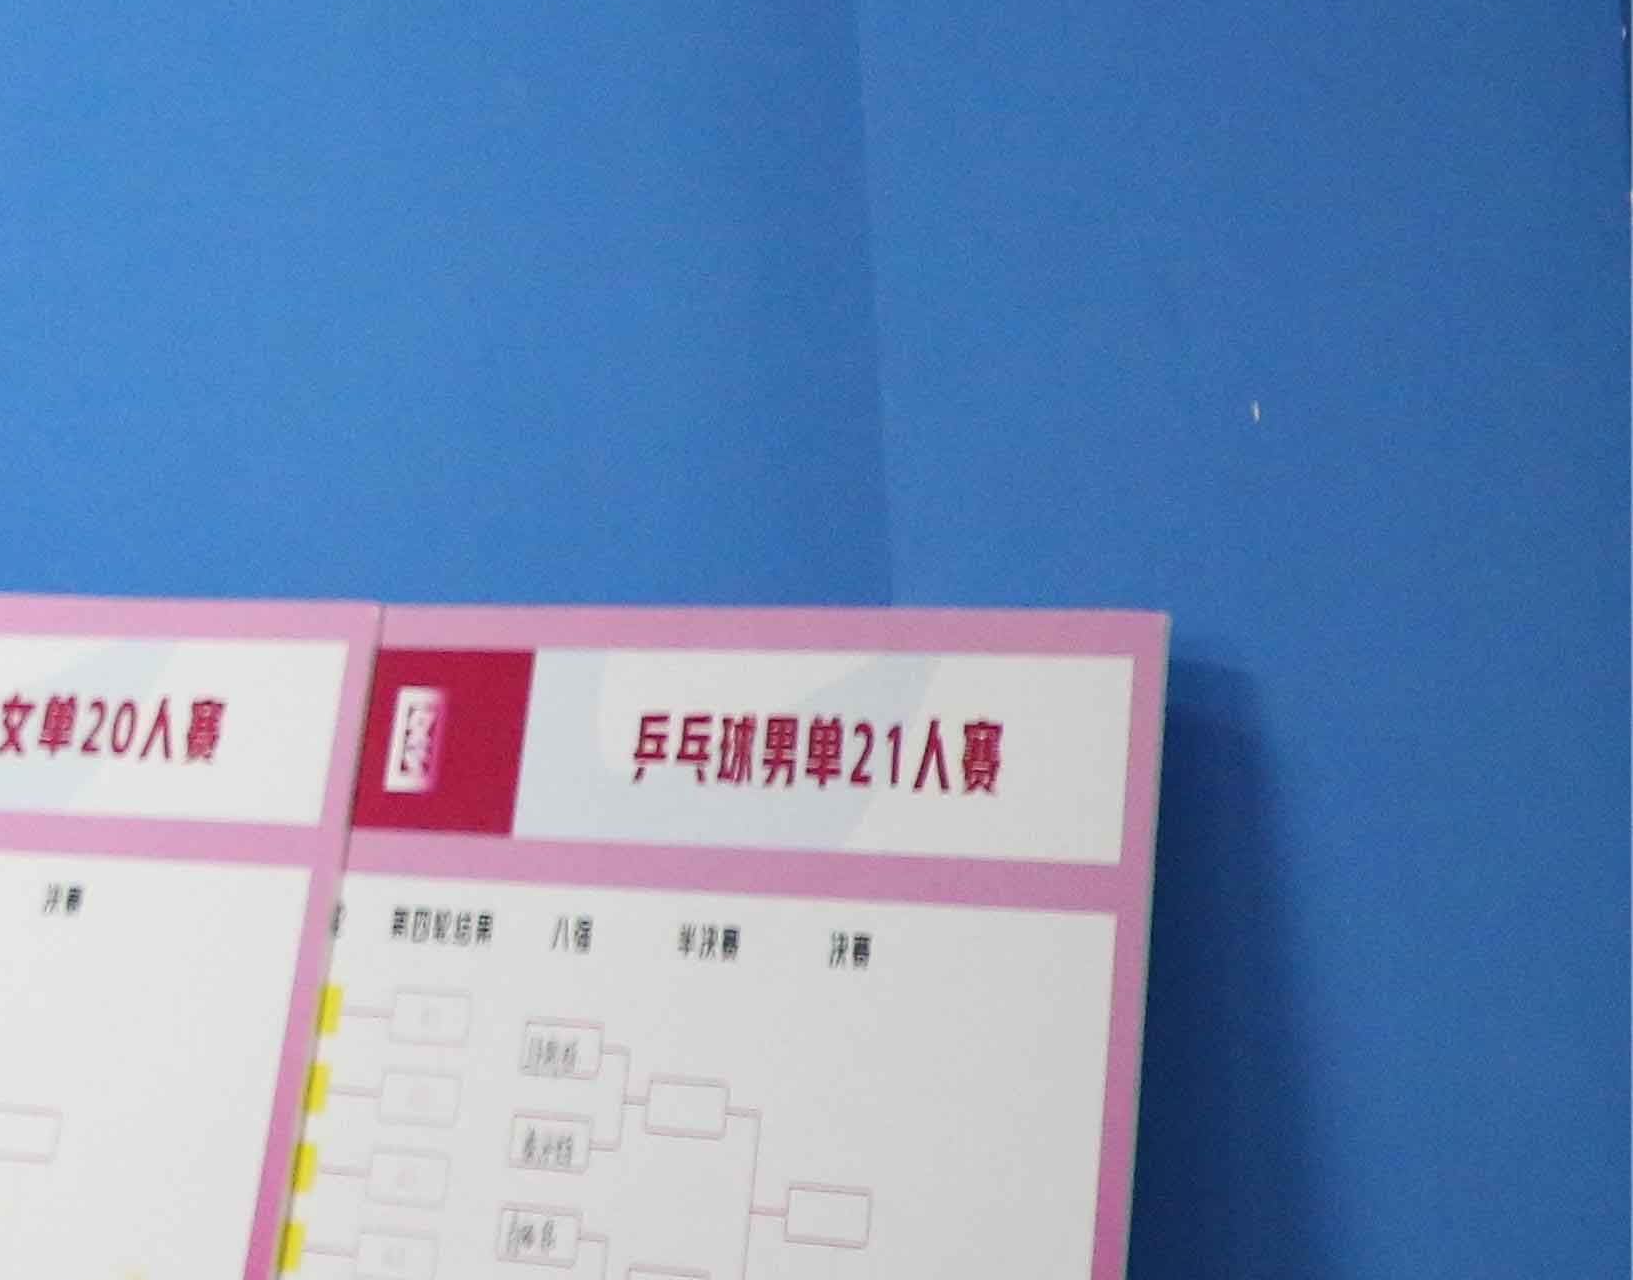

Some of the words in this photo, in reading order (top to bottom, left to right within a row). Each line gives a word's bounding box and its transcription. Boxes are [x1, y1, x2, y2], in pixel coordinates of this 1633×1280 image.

[632, 712, 1005, 795] 乒乓球男单21人赛
[677, 923, 742, 963] 半决赛
[828, 931, 873, 969] 决赛
